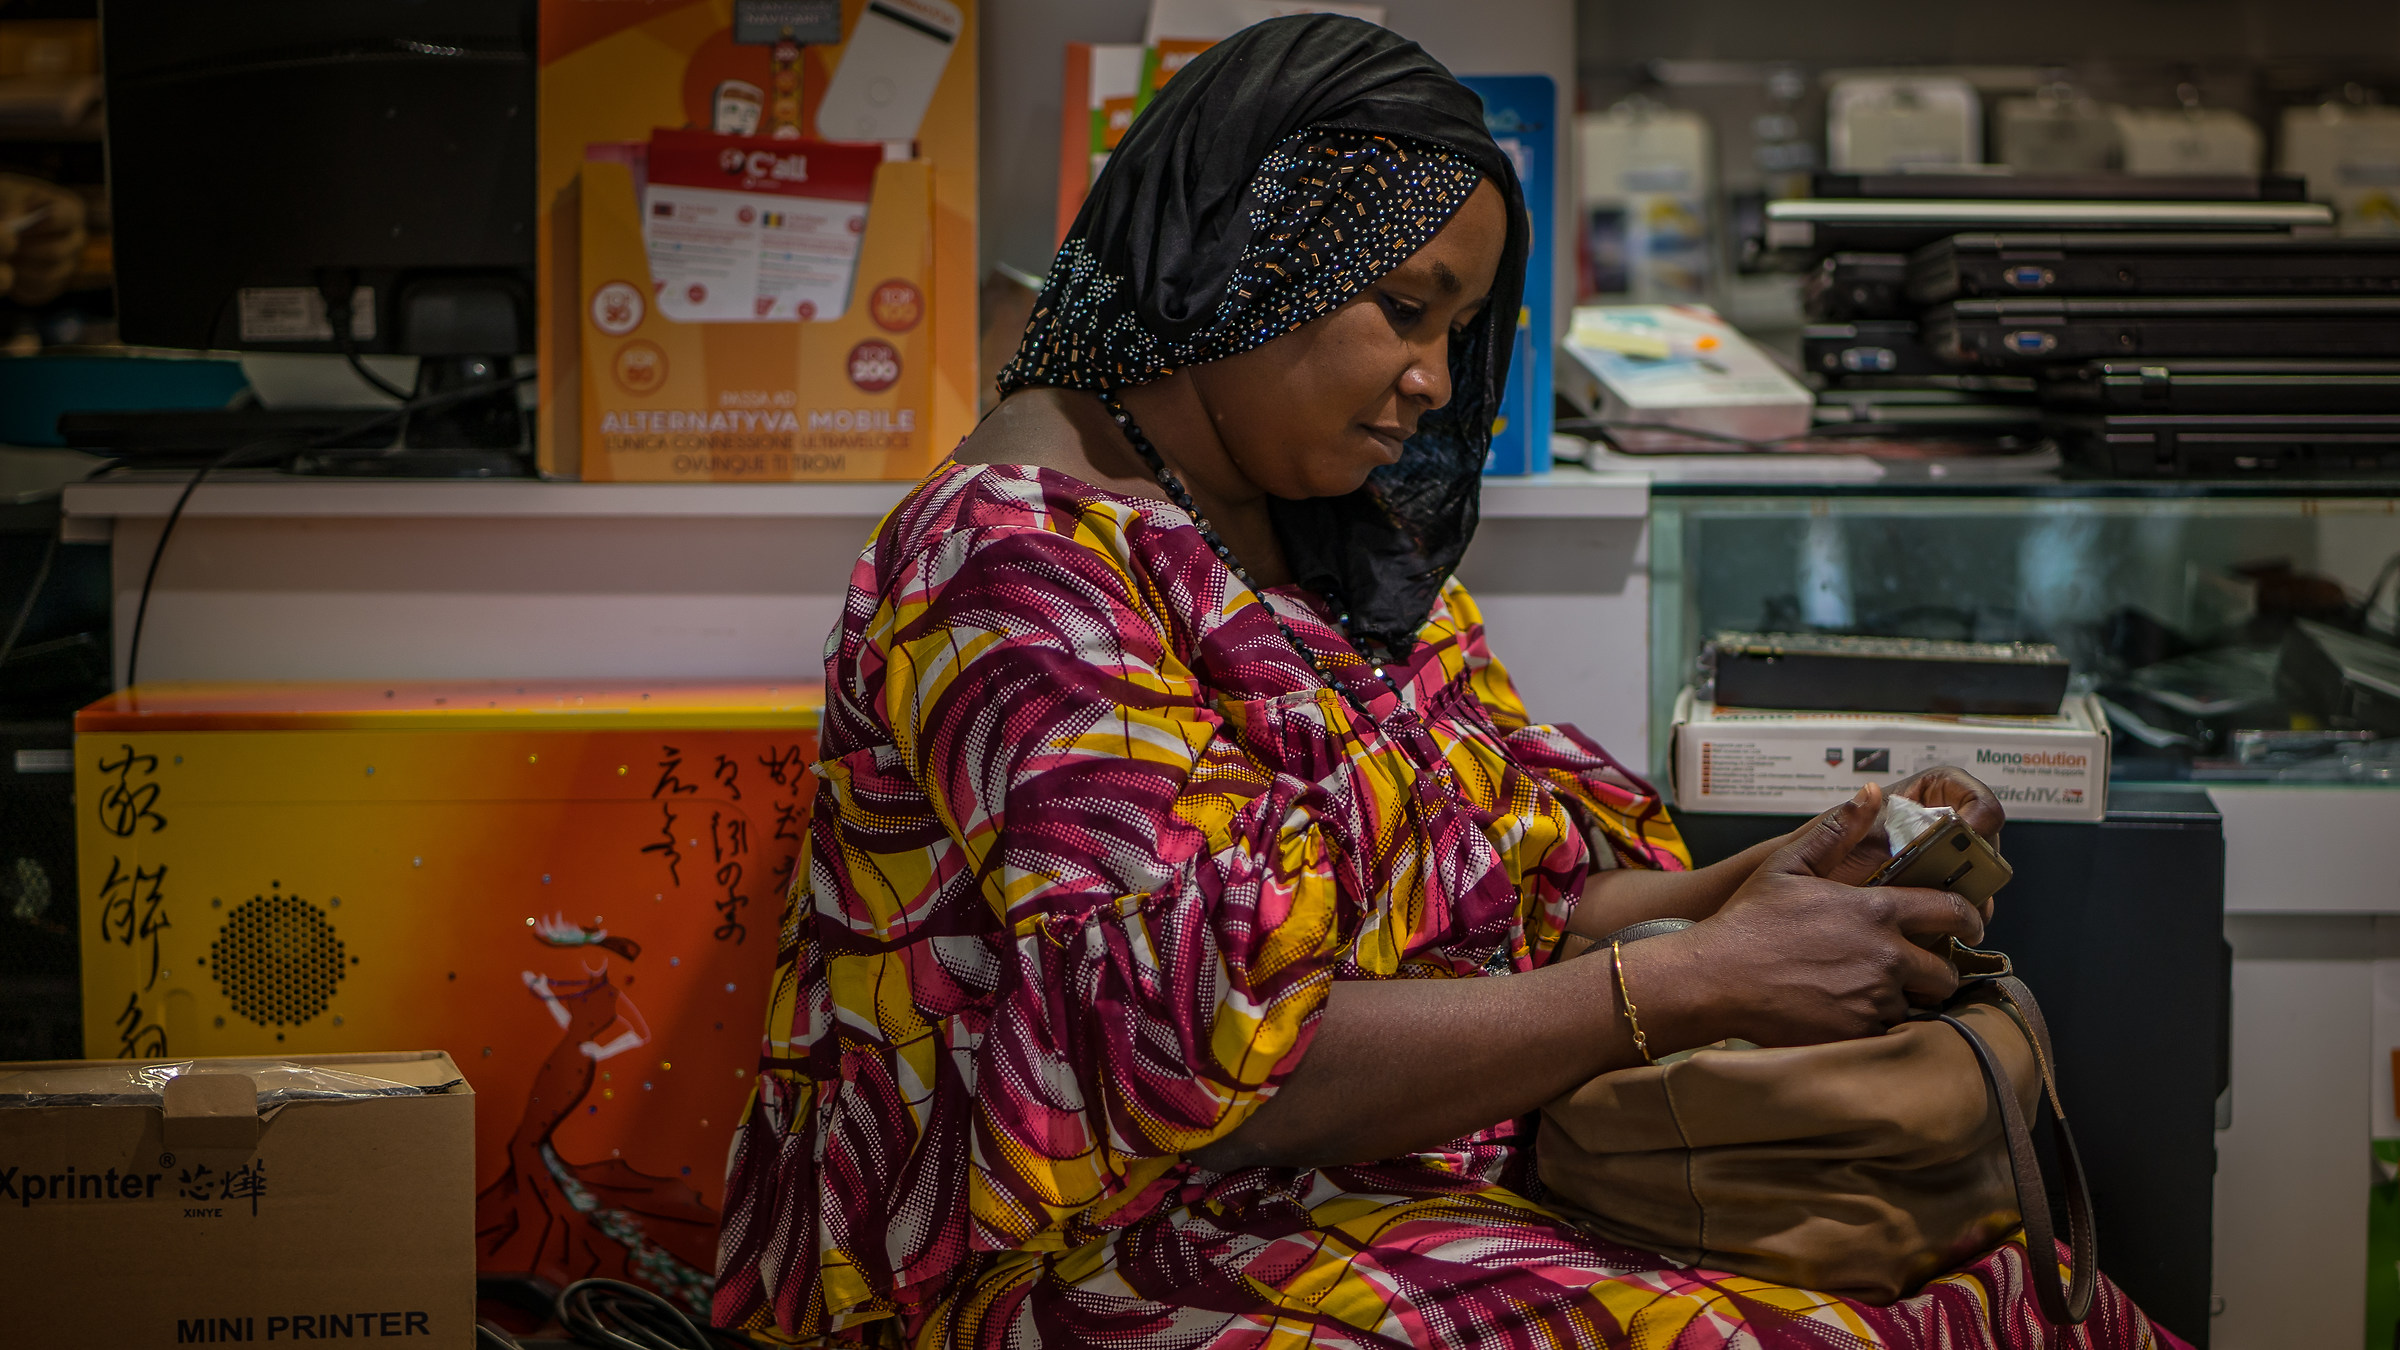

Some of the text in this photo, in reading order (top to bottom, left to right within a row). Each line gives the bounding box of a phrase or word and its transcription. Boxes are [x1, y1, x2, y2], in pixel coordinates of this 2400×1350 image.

[852, 360, 898, 382] 200
[601, 409, 916, 433] ALTERNATYVA MOBILE
[673, 434, 794, 451] CONNESSIONE
[673, 453, 846, 474] OVUNQUE TI TROVI
[1977, 749, 2086, 766] Monosolution
[183, 1208, 223, 1218] XINYE
[177, 1311, 431, 1344] MINI PRINTER
